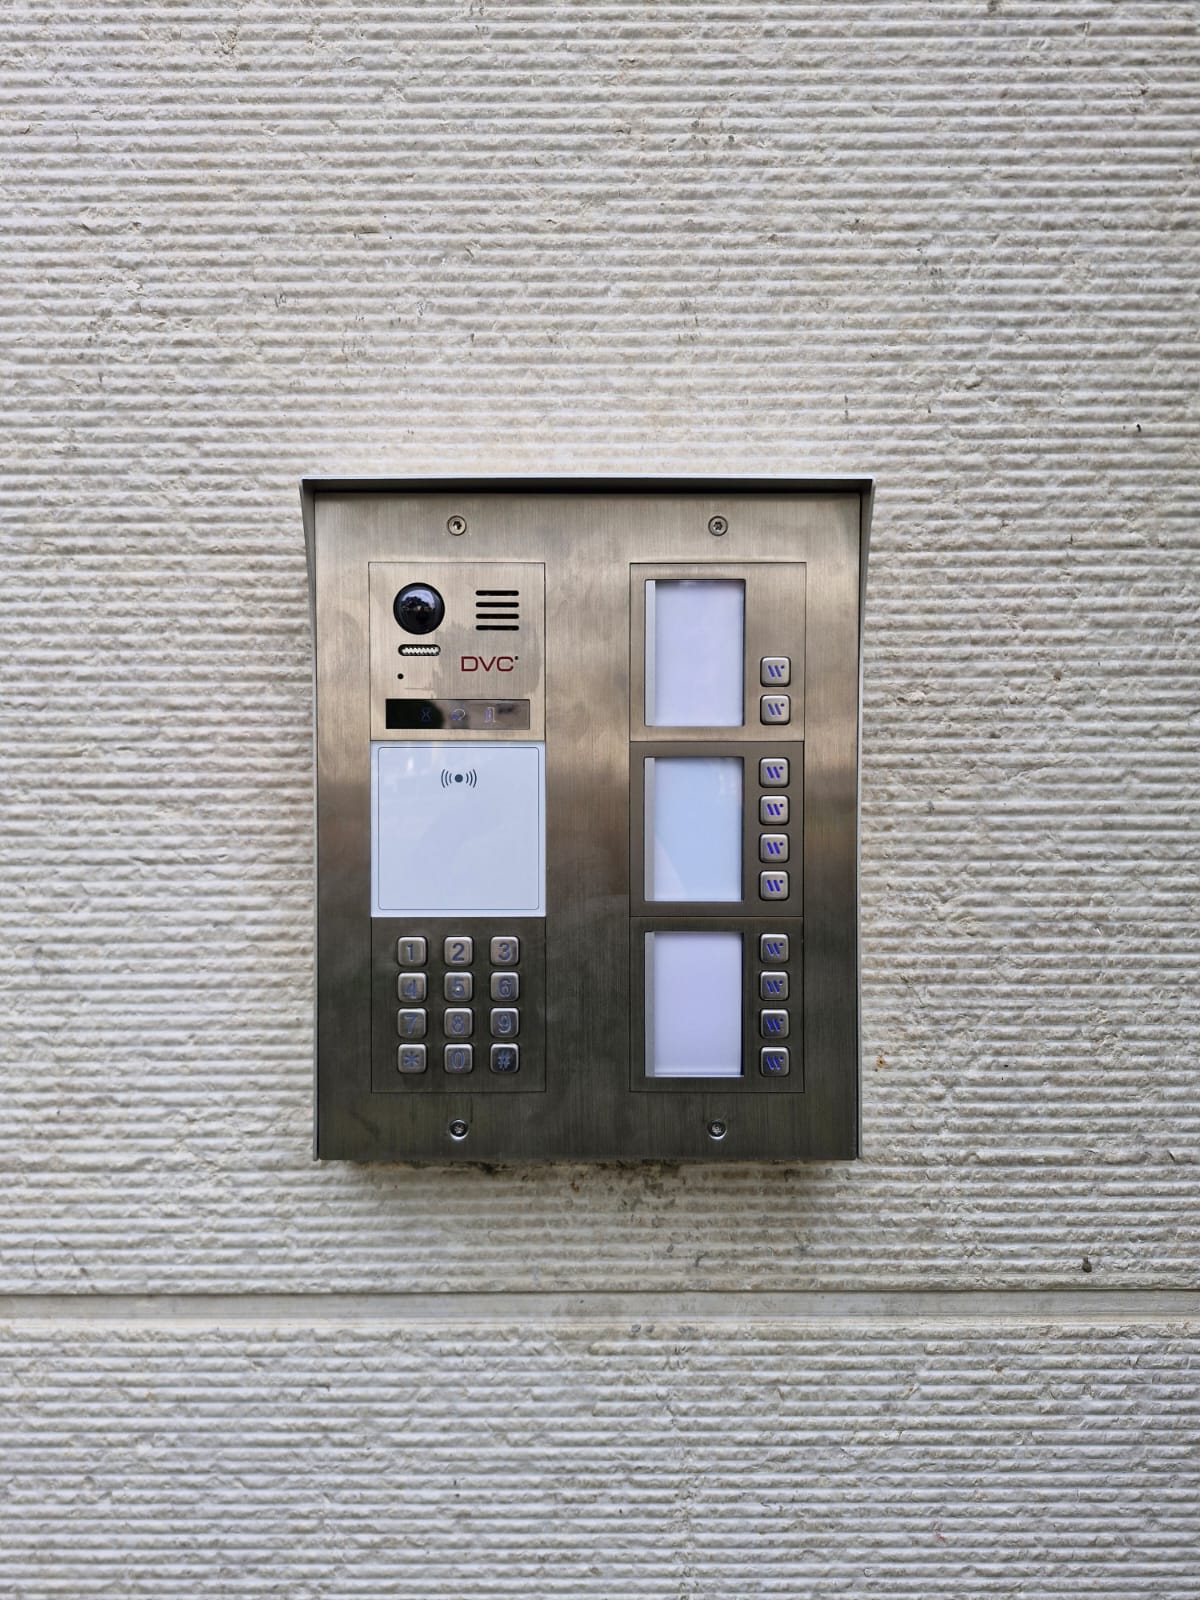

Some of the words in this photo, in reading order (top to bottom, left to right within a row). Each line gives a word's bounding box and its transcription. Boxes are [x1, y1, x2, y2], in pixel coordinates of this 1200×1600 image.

[461, 656, 514, 672] DVC
[452, 942, 465, 961] 2
[498, 942, 511, 961] 3
[404, 978, 417, 999] 4
[452, 977, 465, 998] 5
[498, 978, 512, 998] 6
[404, 1014, 418, 1034] 7
[451, 1014, 465, 1034] 8
[498, 1014, 512, 1033] 9
